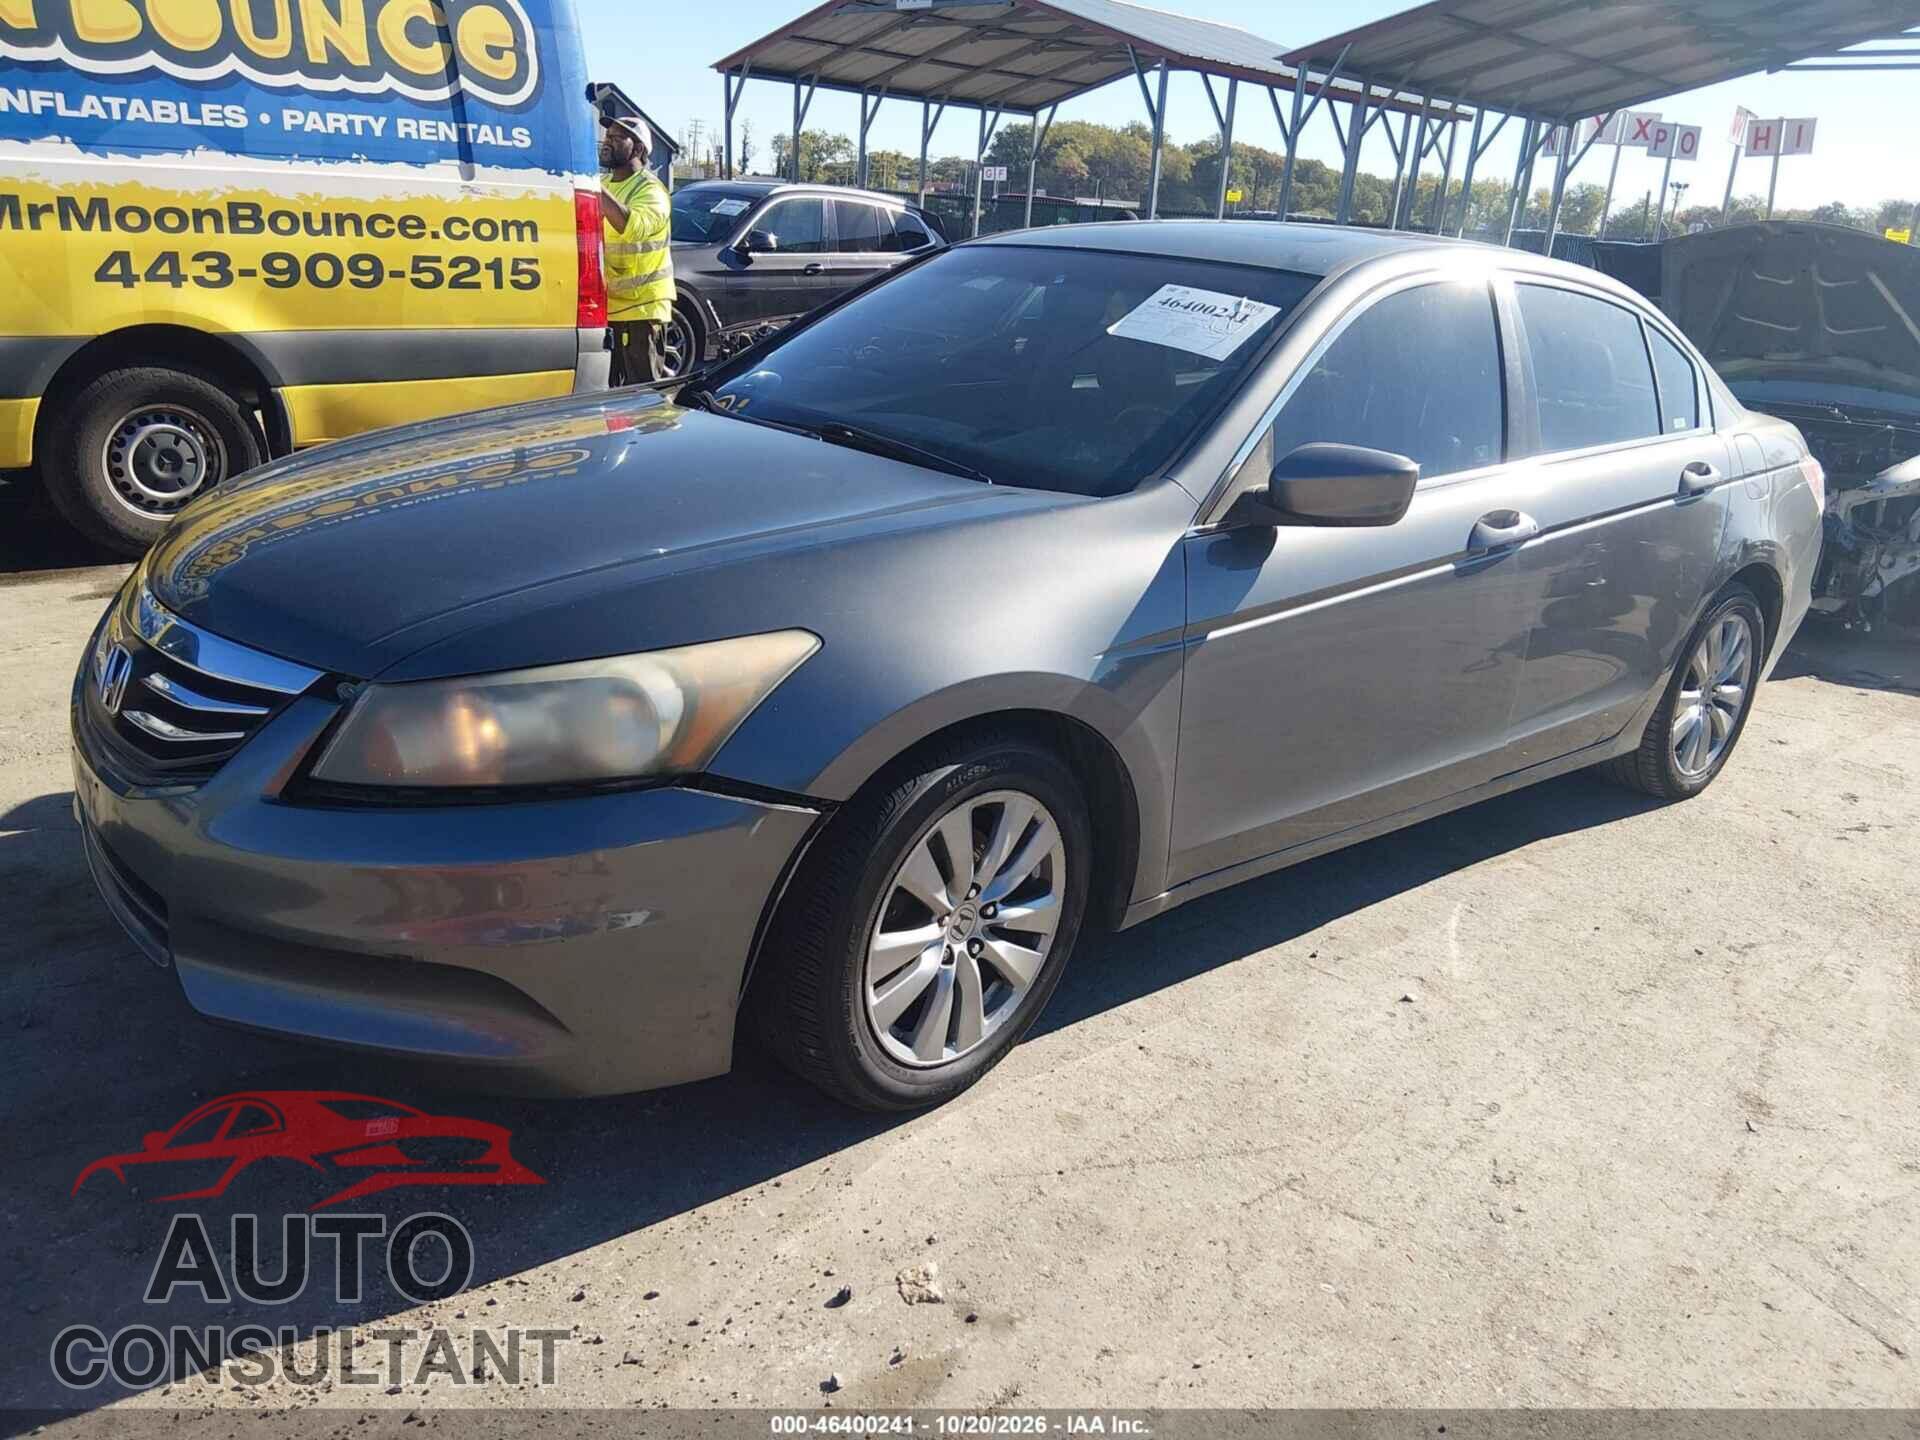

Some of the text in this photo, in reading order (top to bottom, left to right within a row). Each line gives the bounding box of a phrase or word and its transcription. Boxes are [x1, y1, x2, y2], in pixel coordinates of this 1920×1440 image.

[282, 109, 387, 137] PARTY
[396, 117, 531, 148] RENTALS
[1632, 118, 1652, 141] X
[1654, 128, 1668, 151] P
[1753, 126, 1771, 150] H
[94, 250, 542, 291] 443-909-5215
